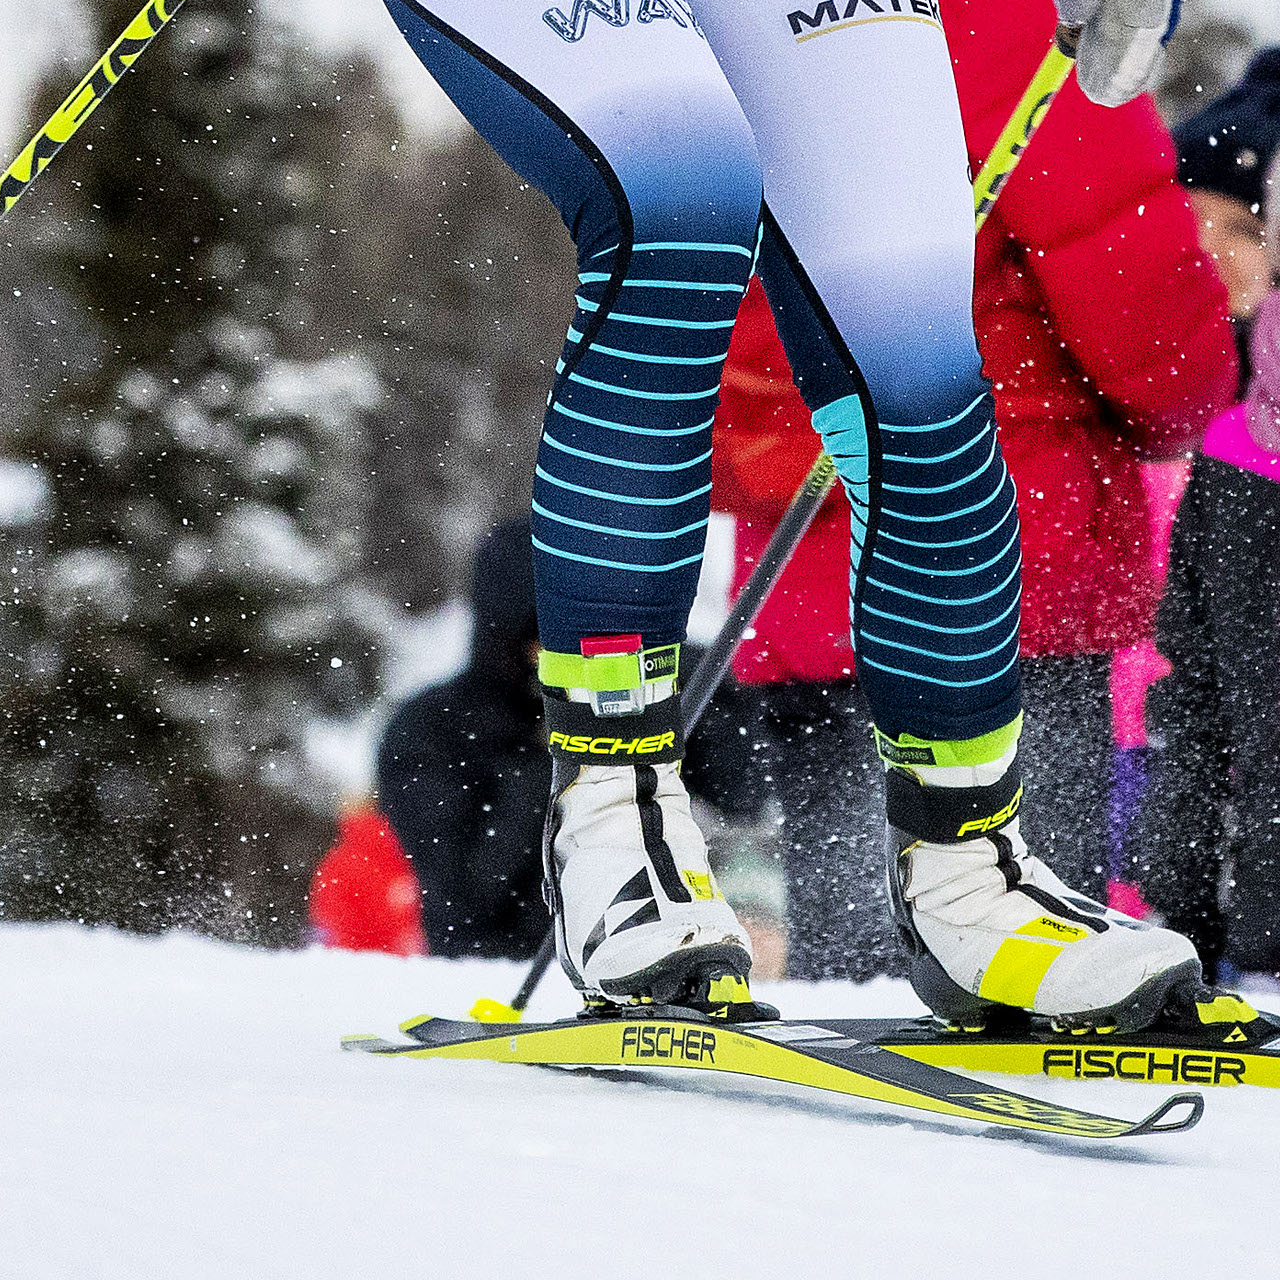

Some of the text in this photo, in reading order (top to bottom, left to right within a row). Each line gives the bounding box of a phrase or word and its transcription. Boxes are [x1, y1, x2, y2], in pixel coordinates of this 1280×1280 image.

[549, 731, 676, 755] FISCHER
[621, 1025, 717, 1064] FISCHER
[1042, 1049, 1247, 1084] FISCHER
